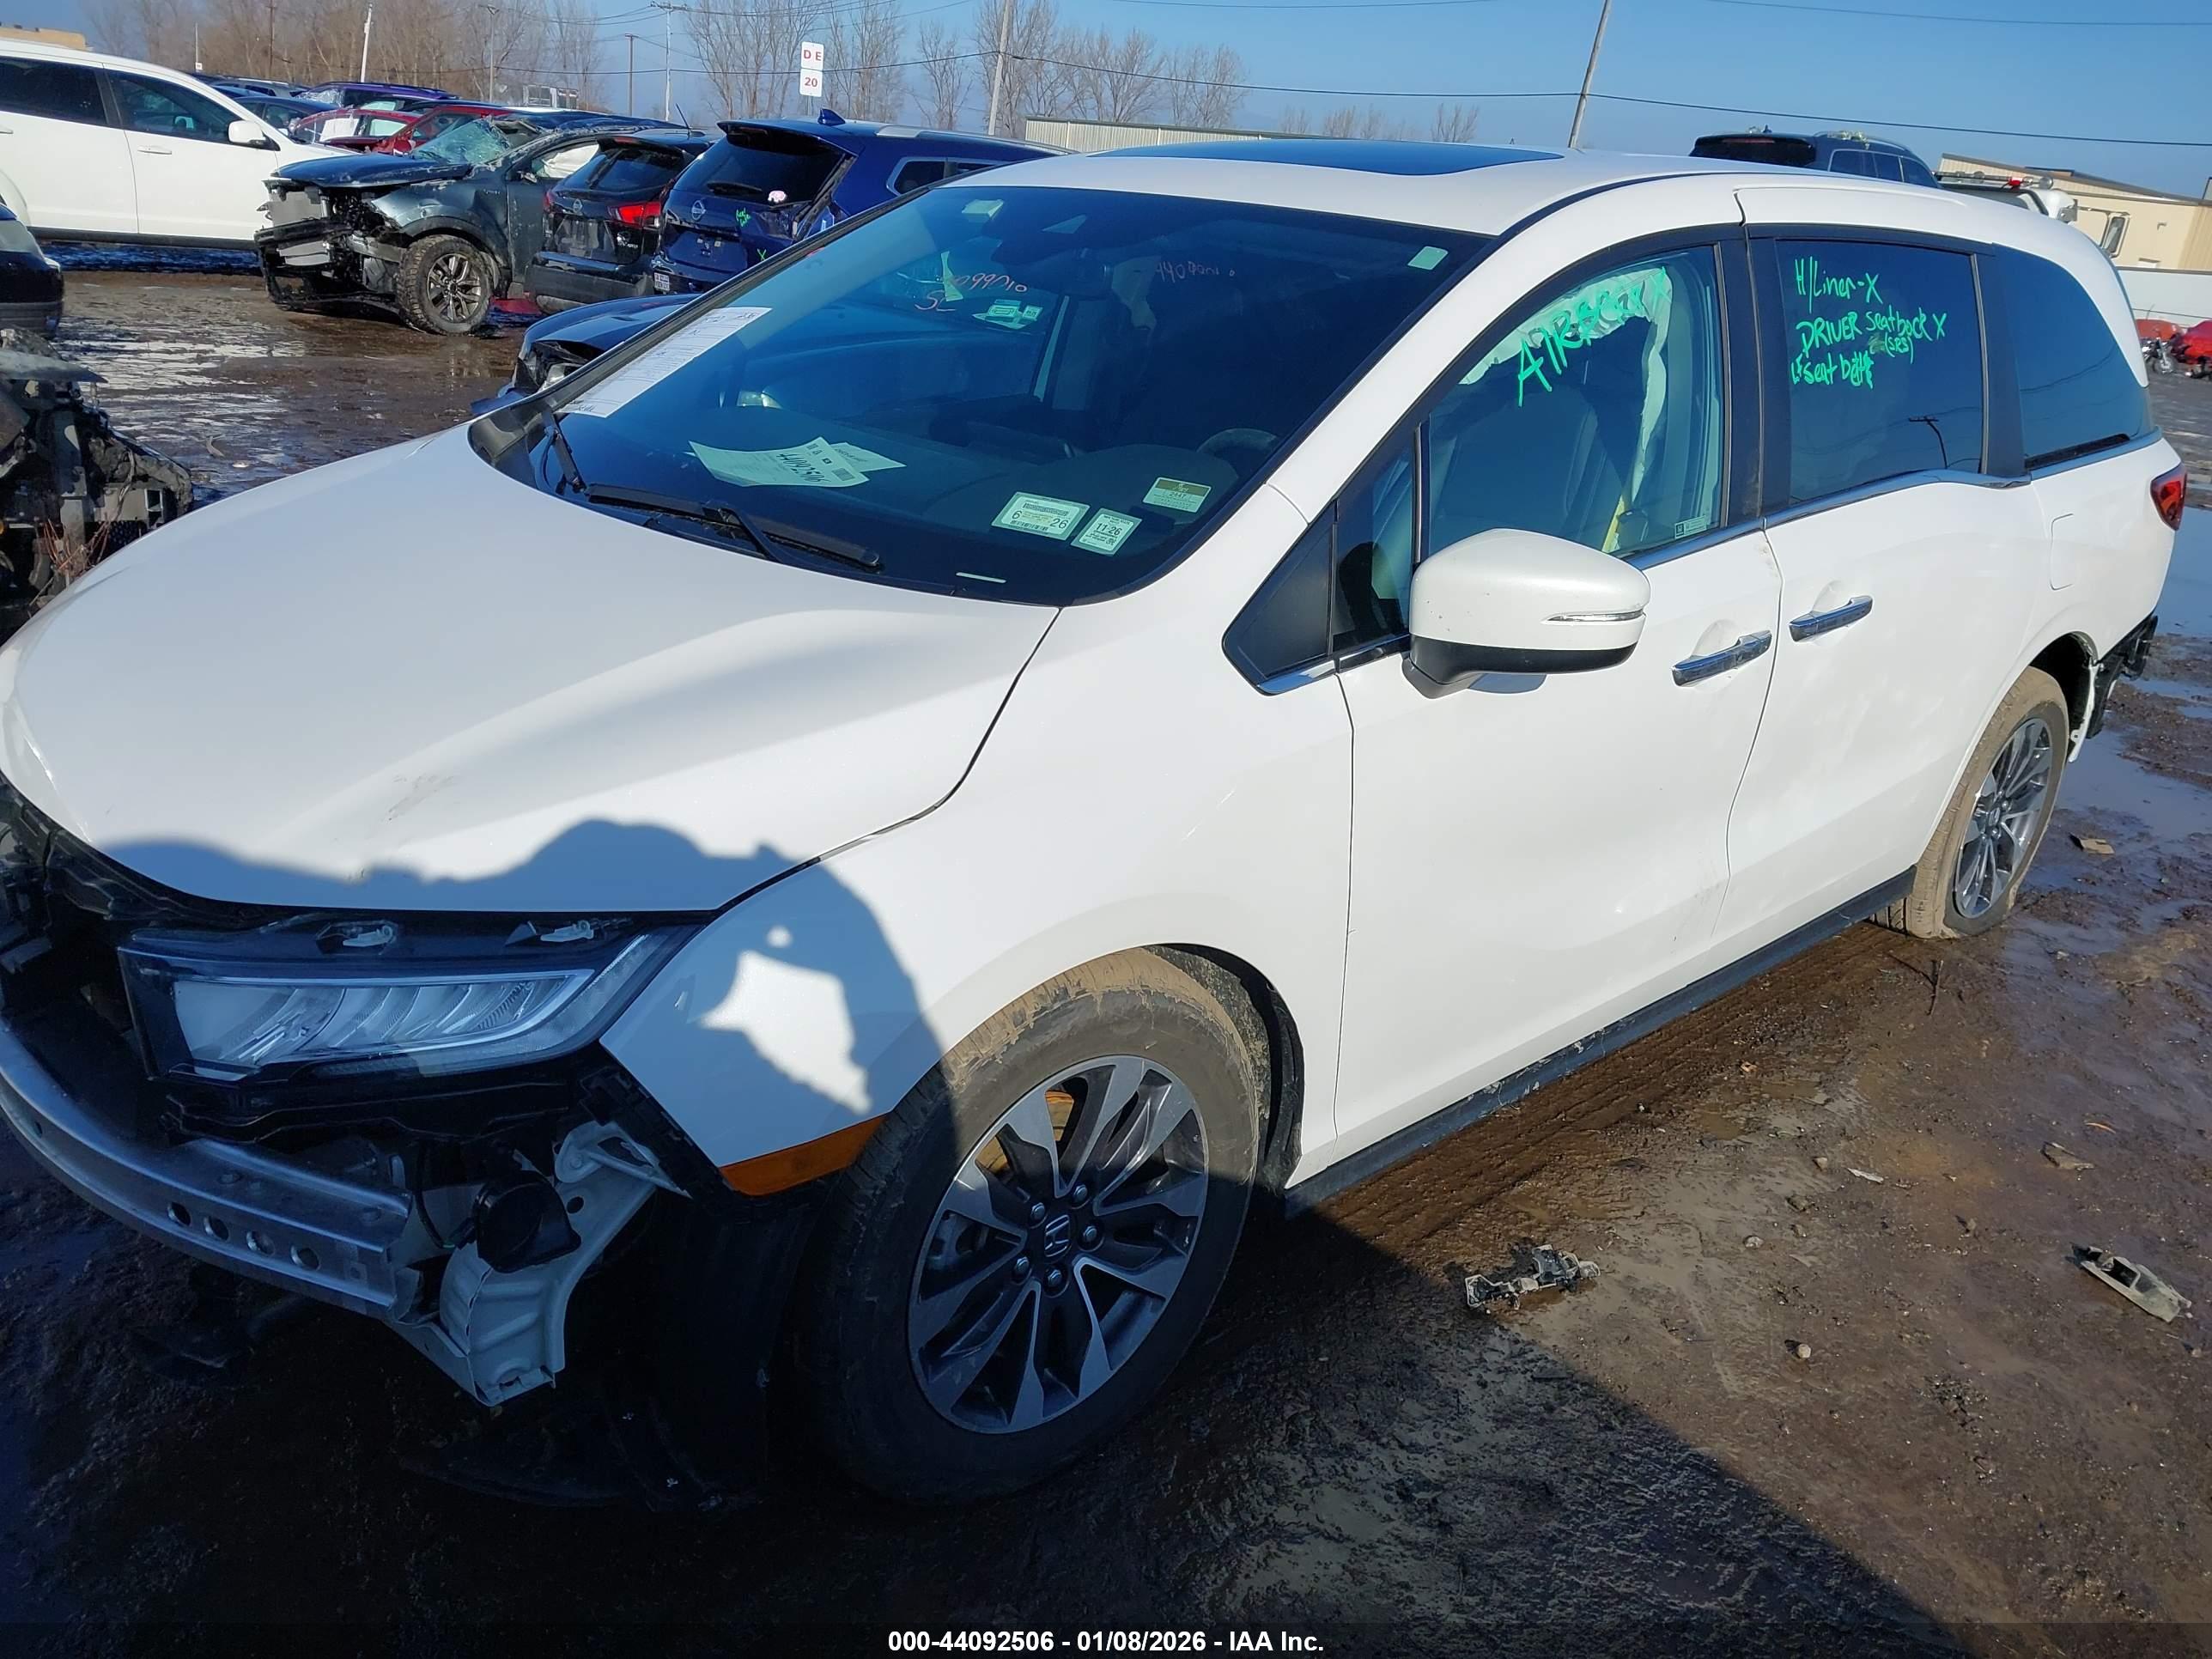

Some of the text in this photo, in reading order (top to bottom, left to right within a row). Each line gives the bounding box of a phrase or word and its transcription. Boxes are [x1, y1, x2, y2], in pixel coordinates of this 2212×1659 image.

[804, 76, 818, 88] 20
[1932, 313, 1948, 340] X
[1012, 510, 1023, 520] 6
[1049, 518, 1069, 530] 26
